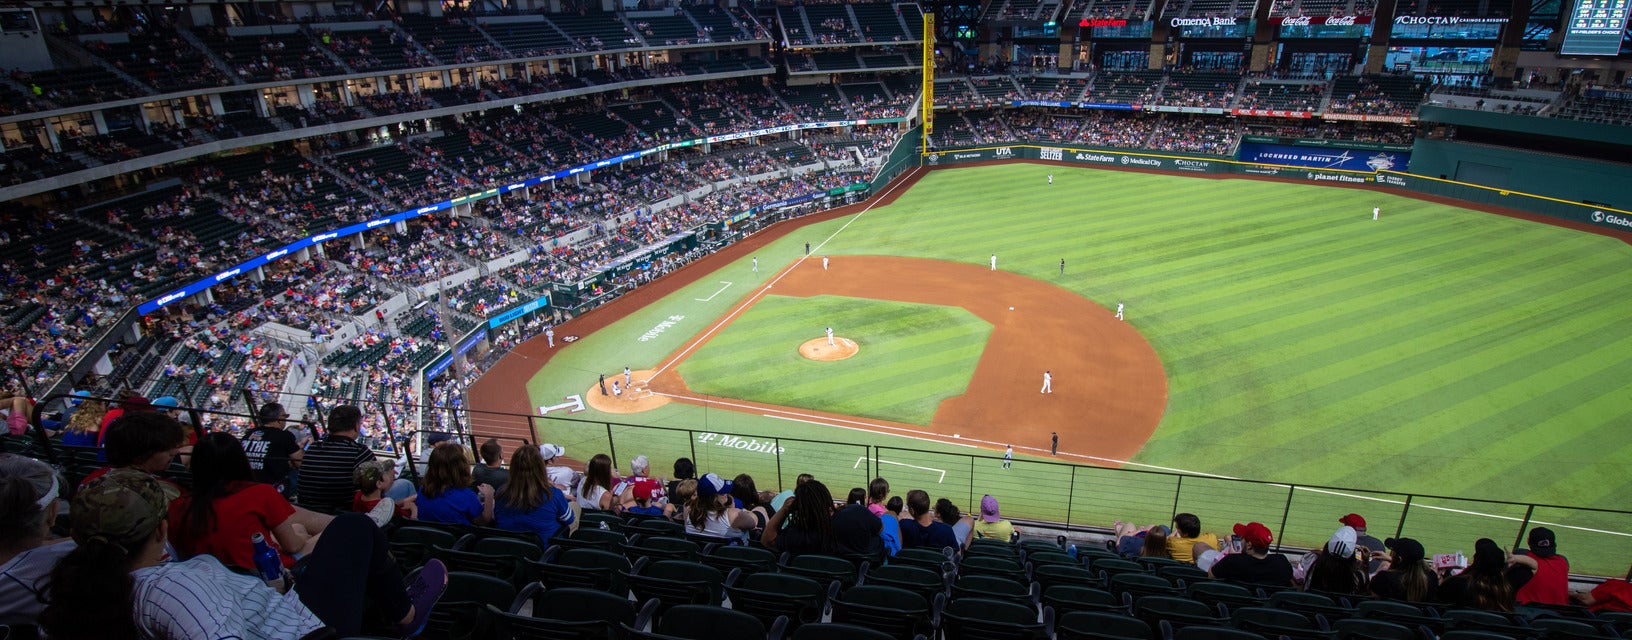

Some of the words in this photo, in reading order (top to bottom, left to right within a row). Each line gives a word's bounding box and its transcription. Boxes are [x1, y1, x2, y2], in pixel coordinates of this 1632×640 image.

[1213, 16, 1237, 26] Bank
[1401, 15, 1460, 25] CHOCTAW
[996, 147, 1012, 155] UTA
[1040, 152, 1063, 160] SELTZER
[1259, 152, 1298, 160] LOCKHEED
[1300, 155, 1332, 163] MARTIN
[1150, 159, 1161, 167] City
[1314, 173, 1339, 181] planet
[1339, 175, 1365, 183] fitness
[250, 440, 271, 453] THE
[715, 434, 785, 456] Mobile
